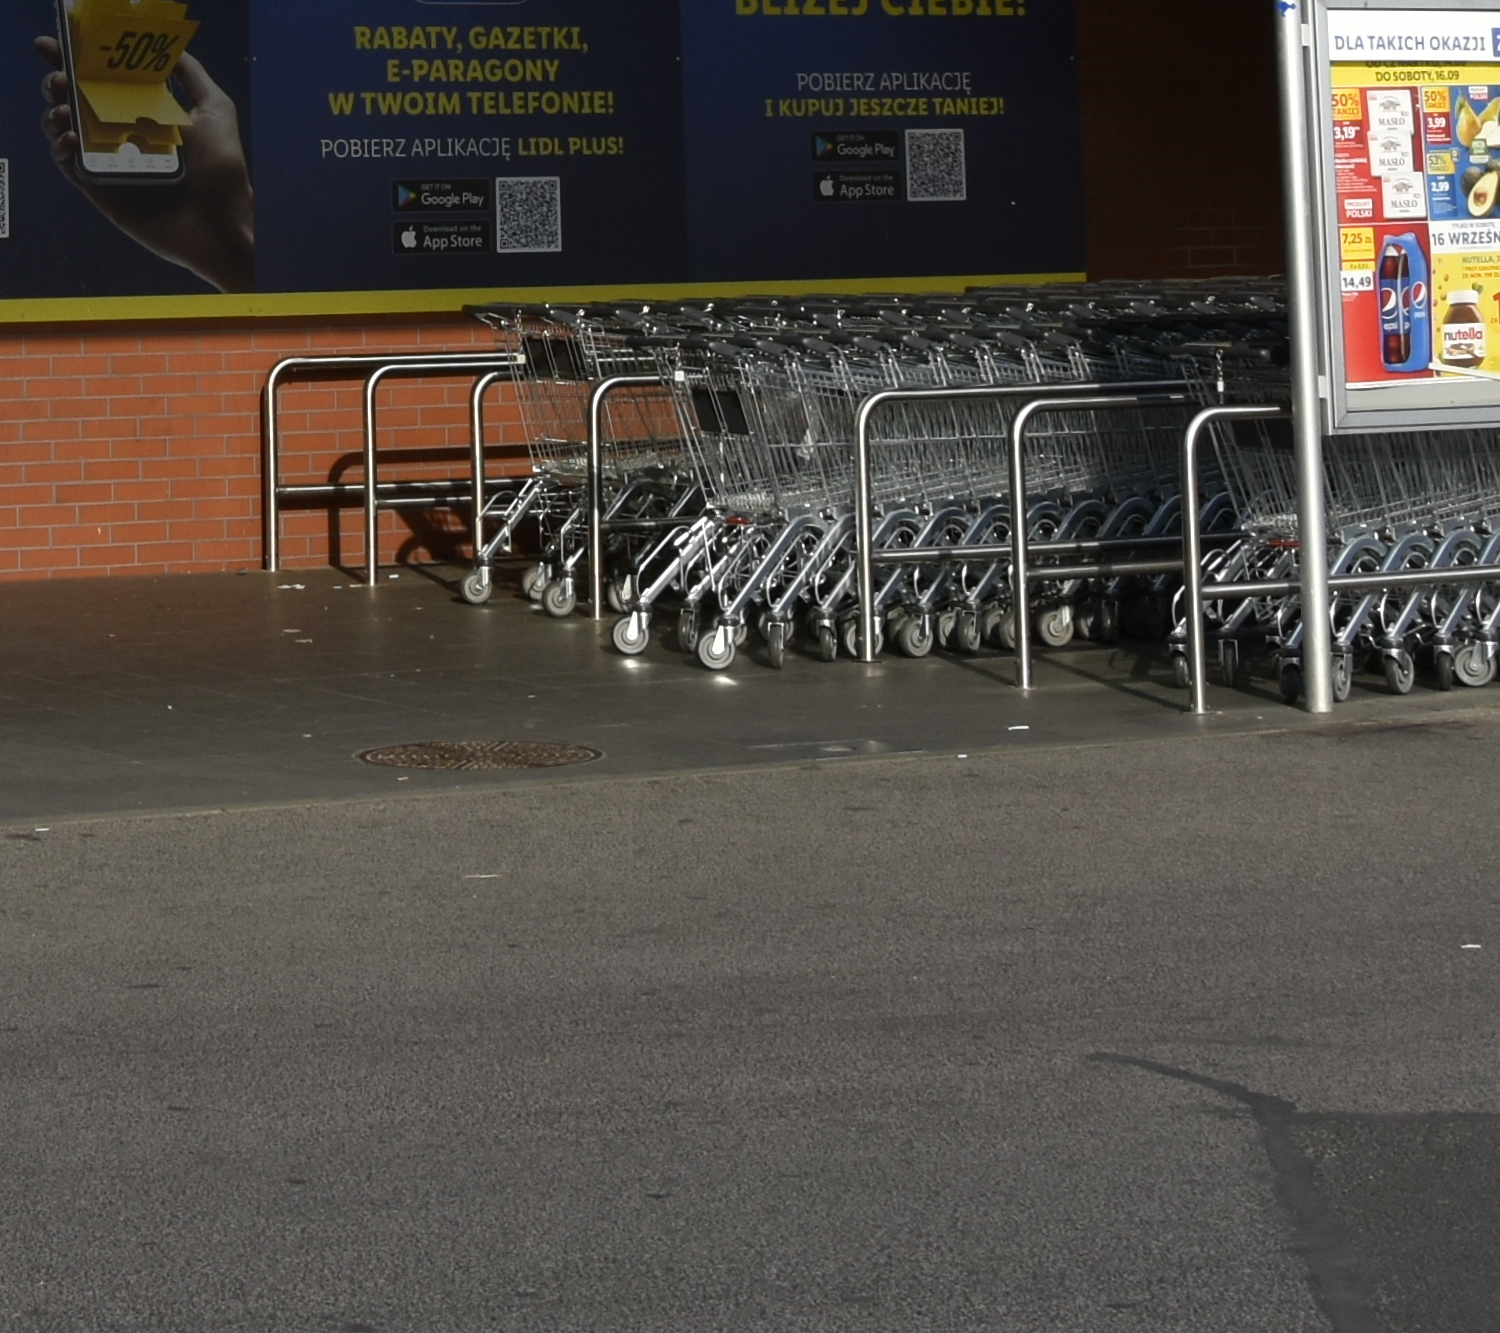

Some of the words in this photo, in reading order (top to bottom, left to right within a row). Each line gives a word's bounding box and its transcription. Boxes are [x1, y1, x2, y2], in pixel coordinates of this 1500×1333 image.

[354, 27, 463, 53] RABATY,
[468, 27, 589, 53] GAZETKI,
[1334, 35, 1364, 50] DLA
[1367, 36, 1425, 50] TAKICH
[1430, 36, 1486, 51] OKAZJI
[99, 30, 181, 72] -50%
[387, 59, 559, 82] E-PARAGONY
[1375, 71, 1391, 82] DO
[1393, 71, 1434, 82] SOBOTY,
[1435, 70, 1460, 81] 16.09
[797, 72, 875, 91] POBIERZ
[879, 72, 971, 95] APLIKACJĘ
[328, 93, 354, 114] W
[361, 92, 461, 114] TWOIM
[467, 92, 614, 114] TELEFONIE!
[1332, 93, 1358, 107] 50%
[1424, 91, 1447, 102] 50%
[765, 100, 773, 116] I
[779, 99, 844, 116] KUPUJ
[849, 98, 928, 116] JESZCZE
[932, 97, 1004, 116] TANIEJ!
[1427, 117, 1446, 129] 3,99
[1334, 127, 1356, 141] 3,19
[320, 138, 406, 158] POBIERZ
[411, 137, 512, 161] APLIKACJĘ
[518, 137, 564, 155] LIDL
[568, 137, 624, 155] PLUS!
[421, 191, 460, 208] Google
[462, 191, 484, 207] Play
[1346, 208, 1373, 218] POLSKI
[423, 234, 448, 251] App
[450, 234, 482, 248] Store
[1342, 233, 1362, 246] 7,25
[1431, 233, 1445, 246] 16
[1342, 276, 1372, 289] 14,49
[1444, 329, 1483, 342] nutella
